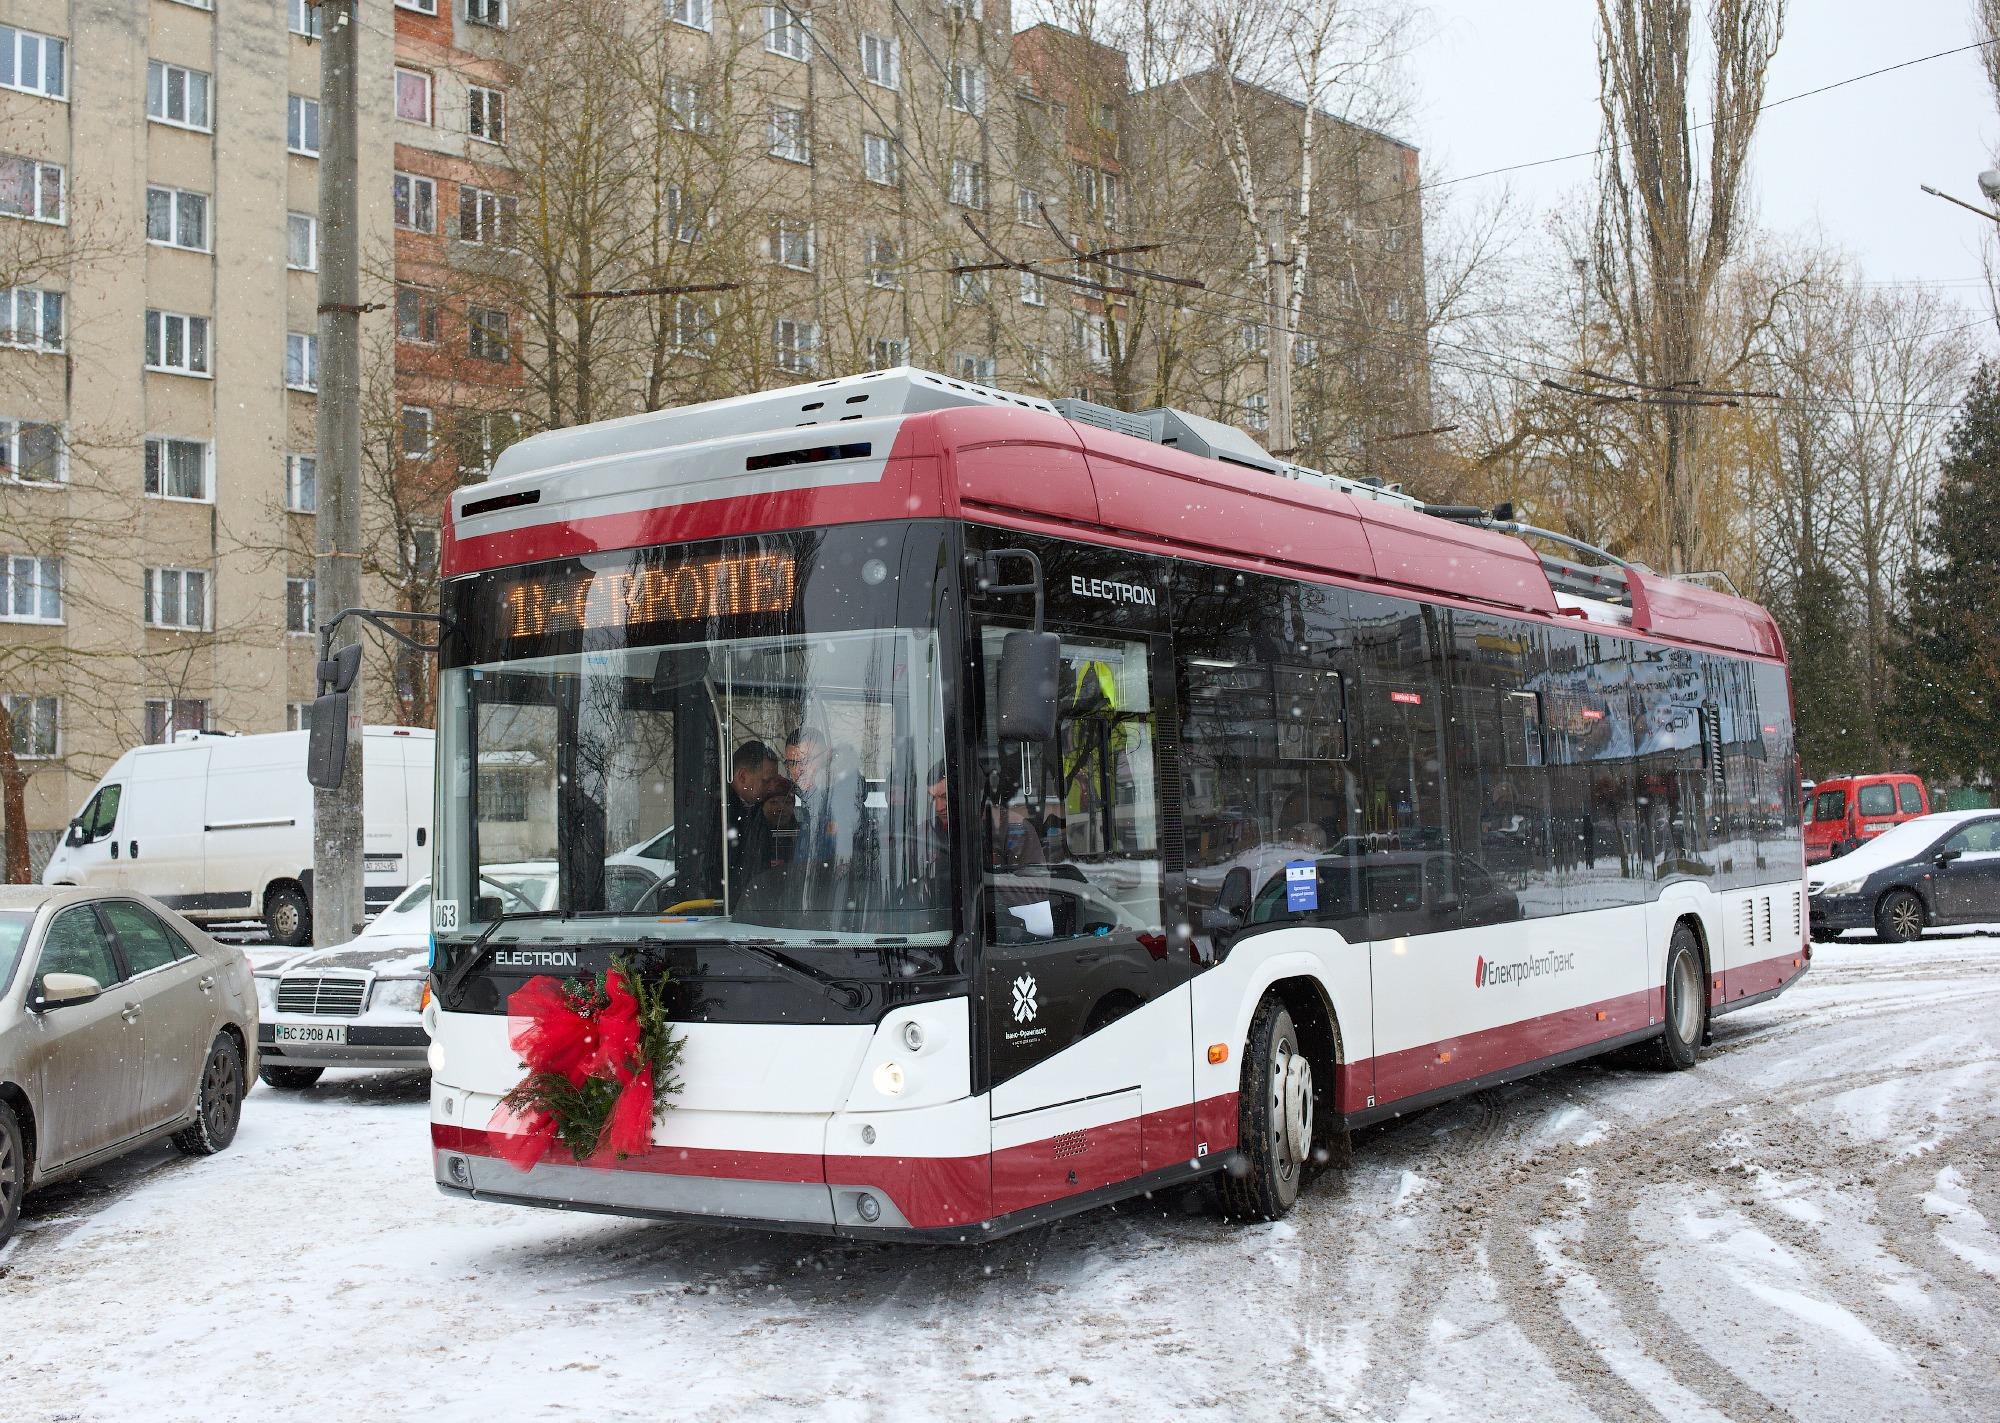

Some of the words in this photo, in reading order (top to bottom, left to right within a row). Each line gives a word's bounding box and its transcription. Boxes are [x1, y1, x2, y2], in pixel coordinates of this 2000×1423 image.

[1071, 574, 1156, 606] ELECTRON
[436, 904, 456, 928] 063
[495, 950, 577, 967] ELECTRON
[1488, 950, 1575, 987] ЕлектроАвтоТранс
[283, 1027, 298, 1040] BC
[299, 1027, 324, 1041] 2908
[326, 1028, 340, 1041] AI
